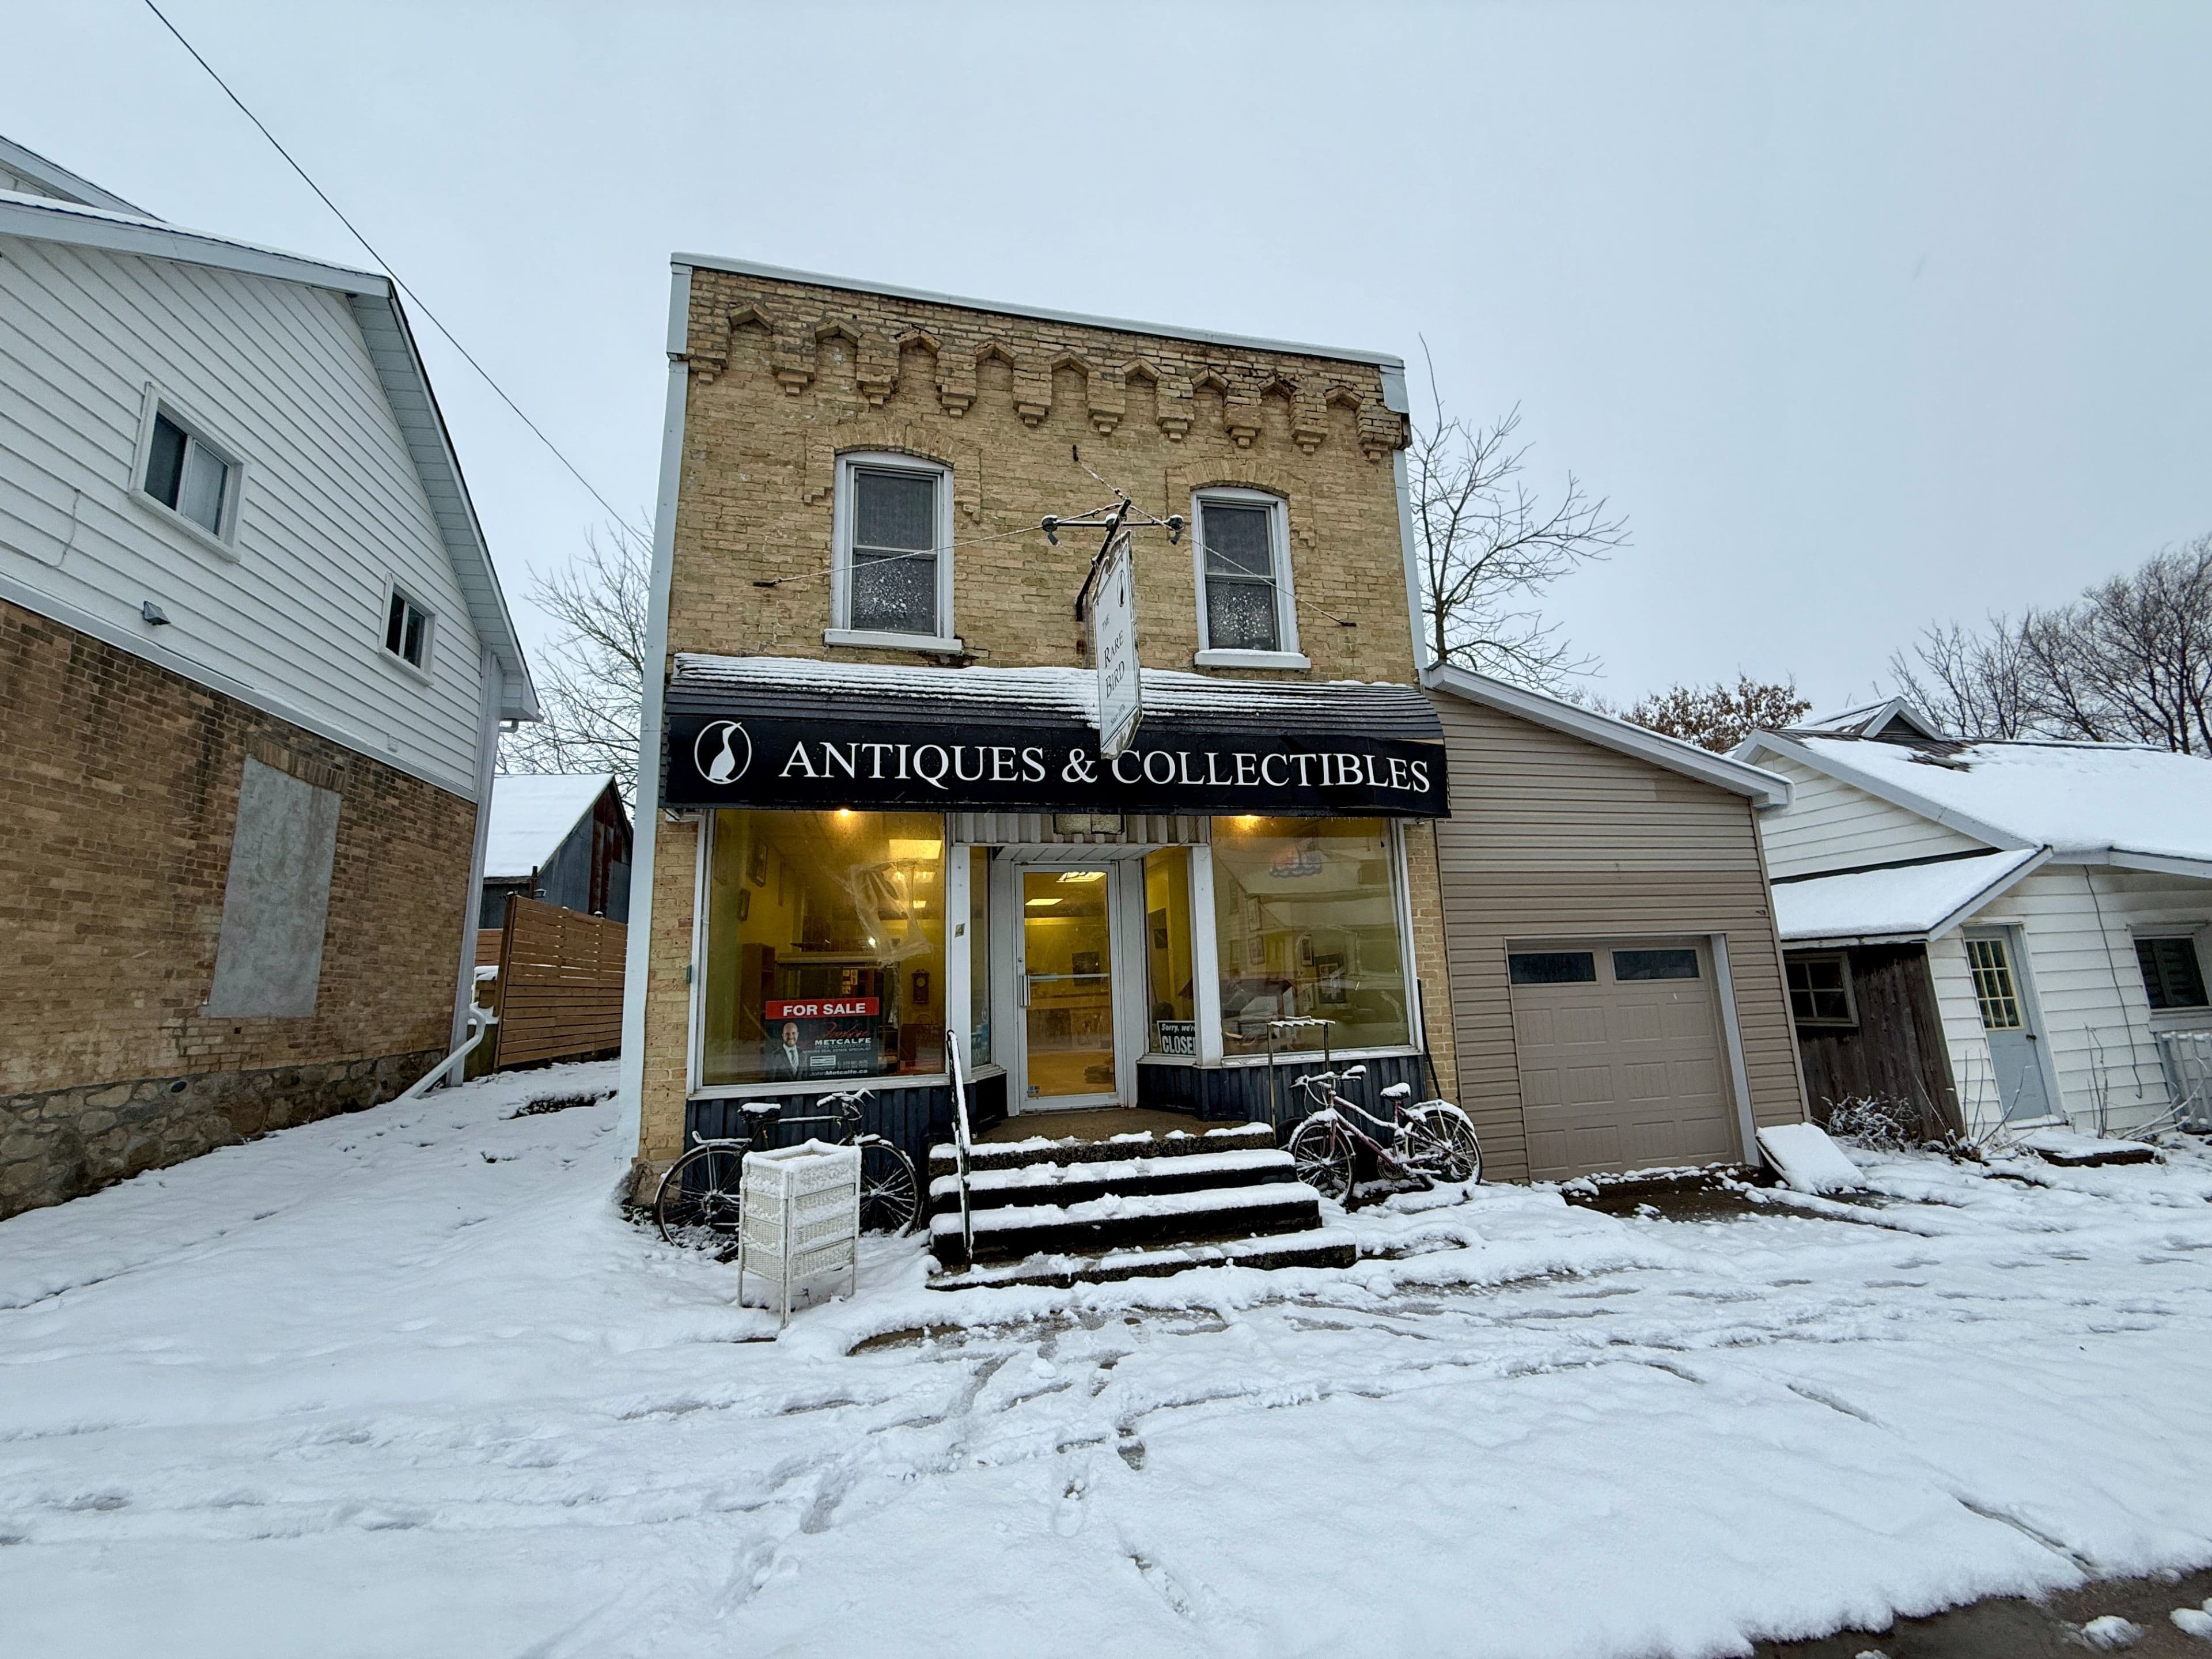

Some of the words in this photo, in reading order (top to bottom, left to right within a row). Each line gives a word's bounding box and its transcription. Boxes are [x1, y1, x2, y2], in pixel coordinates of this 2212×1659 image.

[1104, 630, 1123, 669] RARE
[1105, 661, 1124, 699] BIRD
[778, 741, 1046, 790] ANTIQUES
[1062, 748, 1098, 783] &
[1111, 749, 1430, 793] COLLECTIBLES
[783, 1004, 818, 1017] FOR
[823, 1002, 866, 1015] SALE
[1161, 1023, 1179, 1033] Sorry,
[815, 1037, 872, 1046] METCALFE
